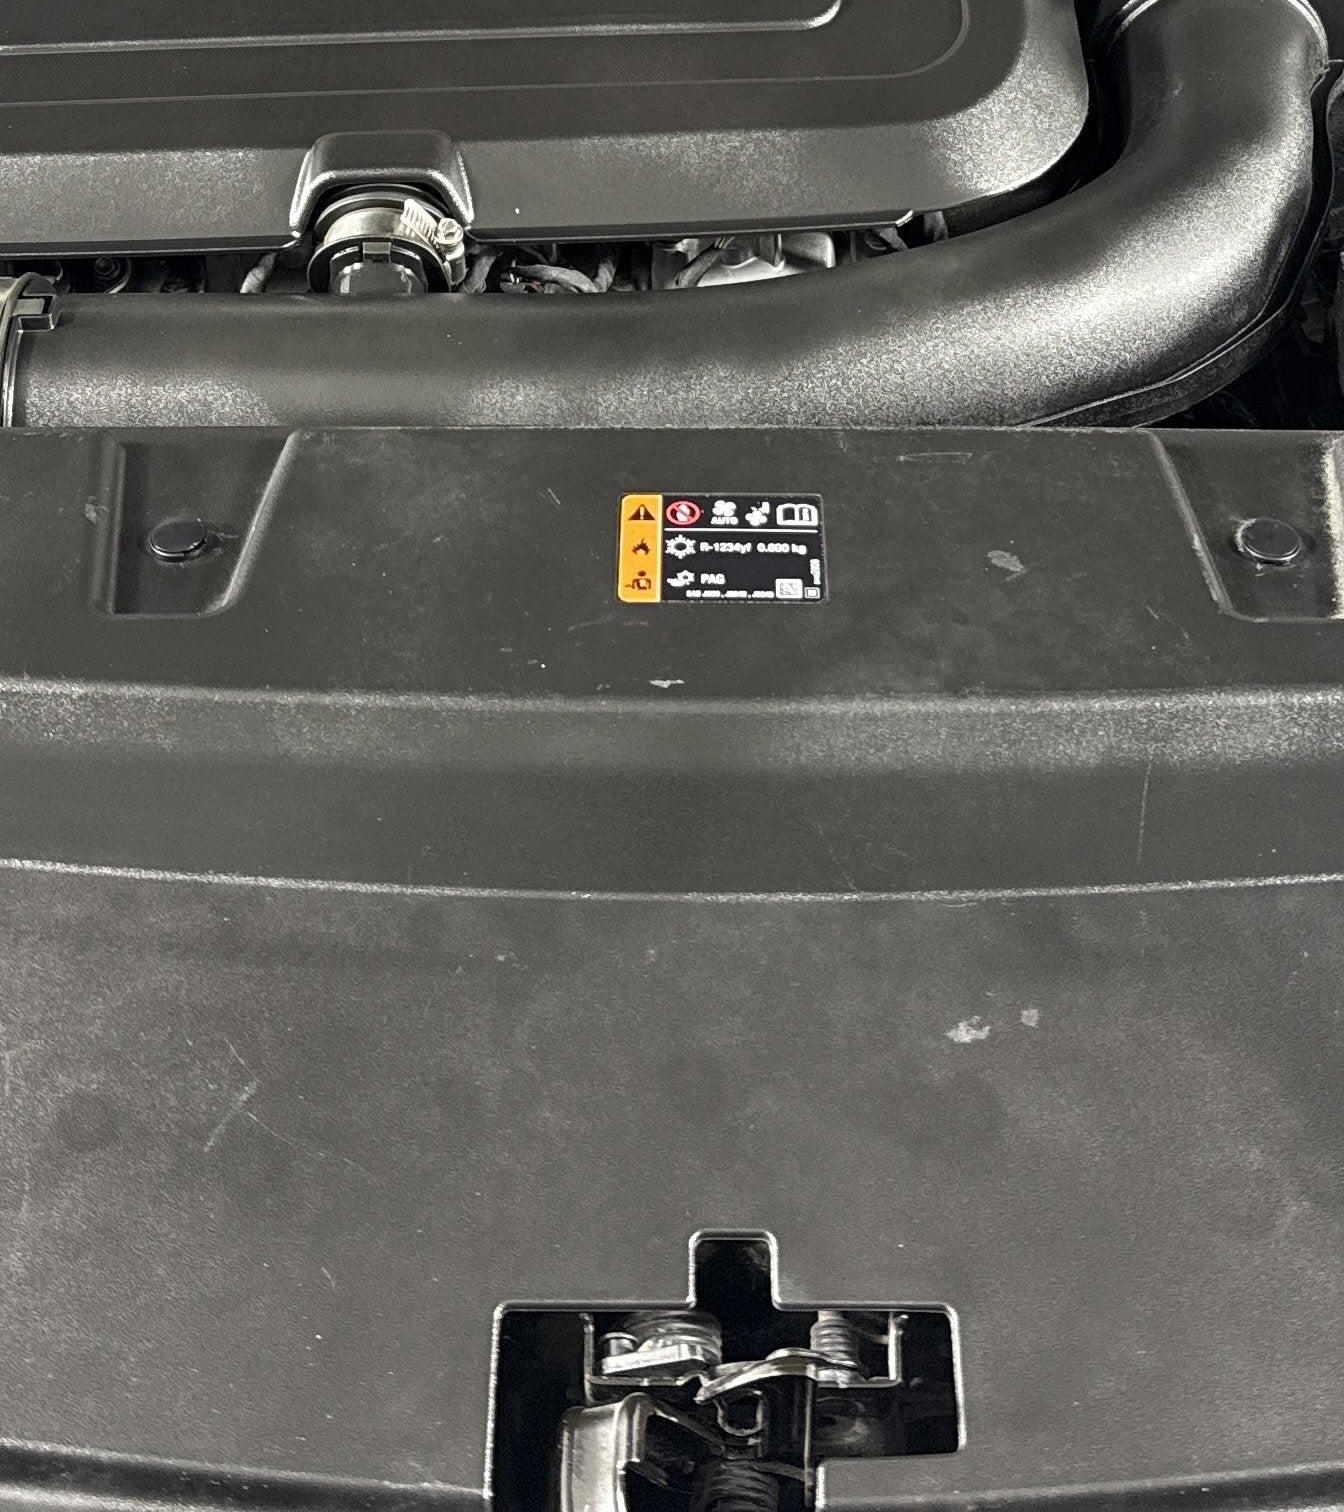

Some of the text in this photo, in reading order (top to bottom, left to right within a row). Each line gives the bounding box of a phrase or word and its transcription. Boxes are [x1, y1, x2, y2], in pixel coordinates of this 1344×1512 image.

[710, 516, 739, 526] AUTO
[699, 541, 752, 554] R-1234yf
[700, 573, 726, 585] PAG
